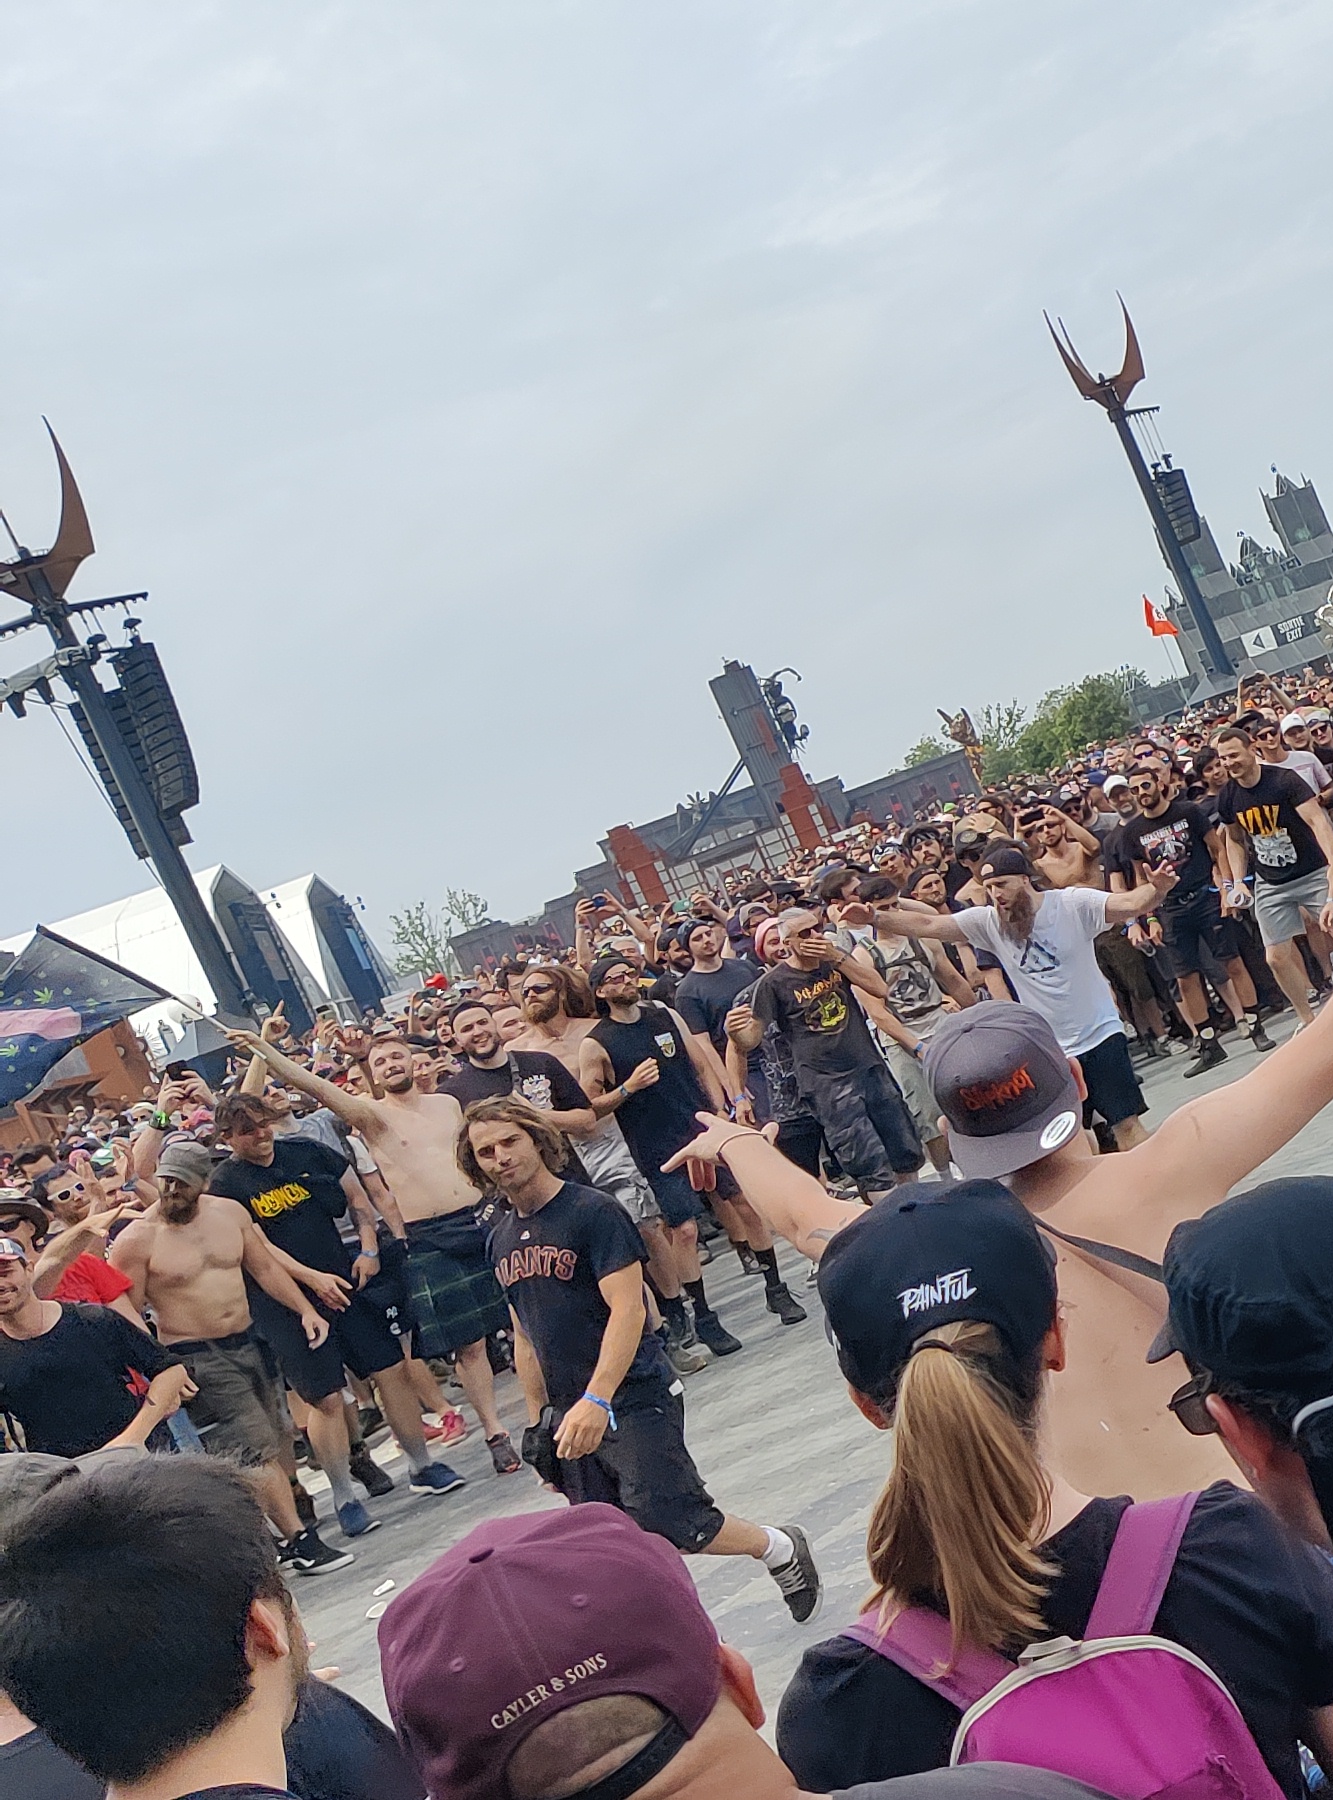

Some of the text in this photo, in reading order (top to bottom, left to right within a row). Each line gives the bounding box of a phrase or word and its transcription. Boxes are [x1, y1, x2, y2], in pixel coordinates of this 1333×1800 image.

[1277, 615, 1305, 634] SORTIE
[1286, 627, 1303, 643] EXIT
[495, 1245, 578, 1287] IANTS
[896, 1268, 977, 1320] PAINFUL
[491, 1652, 607, 1729] CAYLER & SONS
